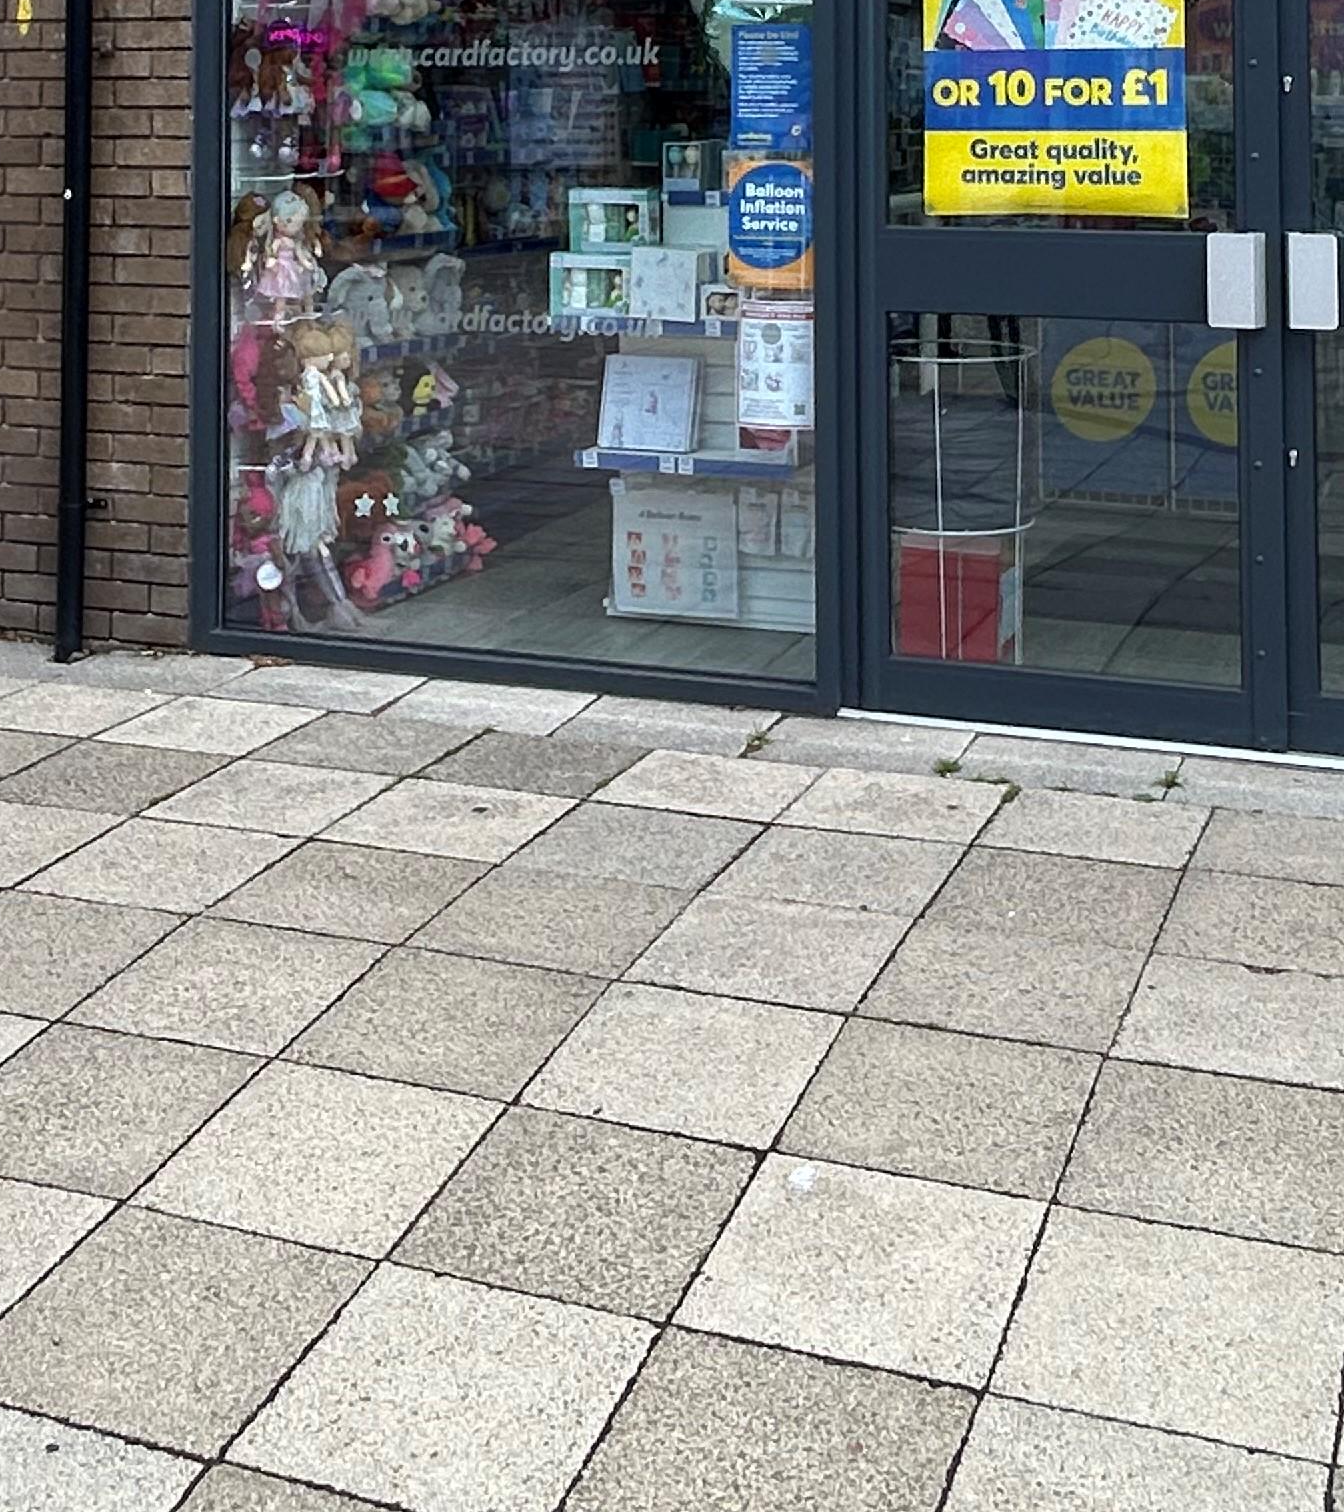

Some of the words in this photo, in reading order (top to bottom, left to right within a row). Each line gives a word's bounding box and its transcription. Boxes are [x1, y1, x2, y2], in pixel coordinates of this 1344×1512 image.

[932, 78, 981, 106] OR
[988, 69, 1036, 106] 10
[1044, 78, 1114, 106] FOR
[1122, 68, 1168, 106] £1
[970, 138, 1040, 161] Great
[1046, 138, 1139, 166] quality,
[961, 163, 1067, 190] amazing
[1074, 164, 1143, 186] value
[744, 182, 805, 199] Balloon
[740, 199, 806, 216] Inflation
[741, 215, 799, 232] Service
[1066, 367, 1142, 389] GREAT
[1067, 388, 1141, 411] VALUE
